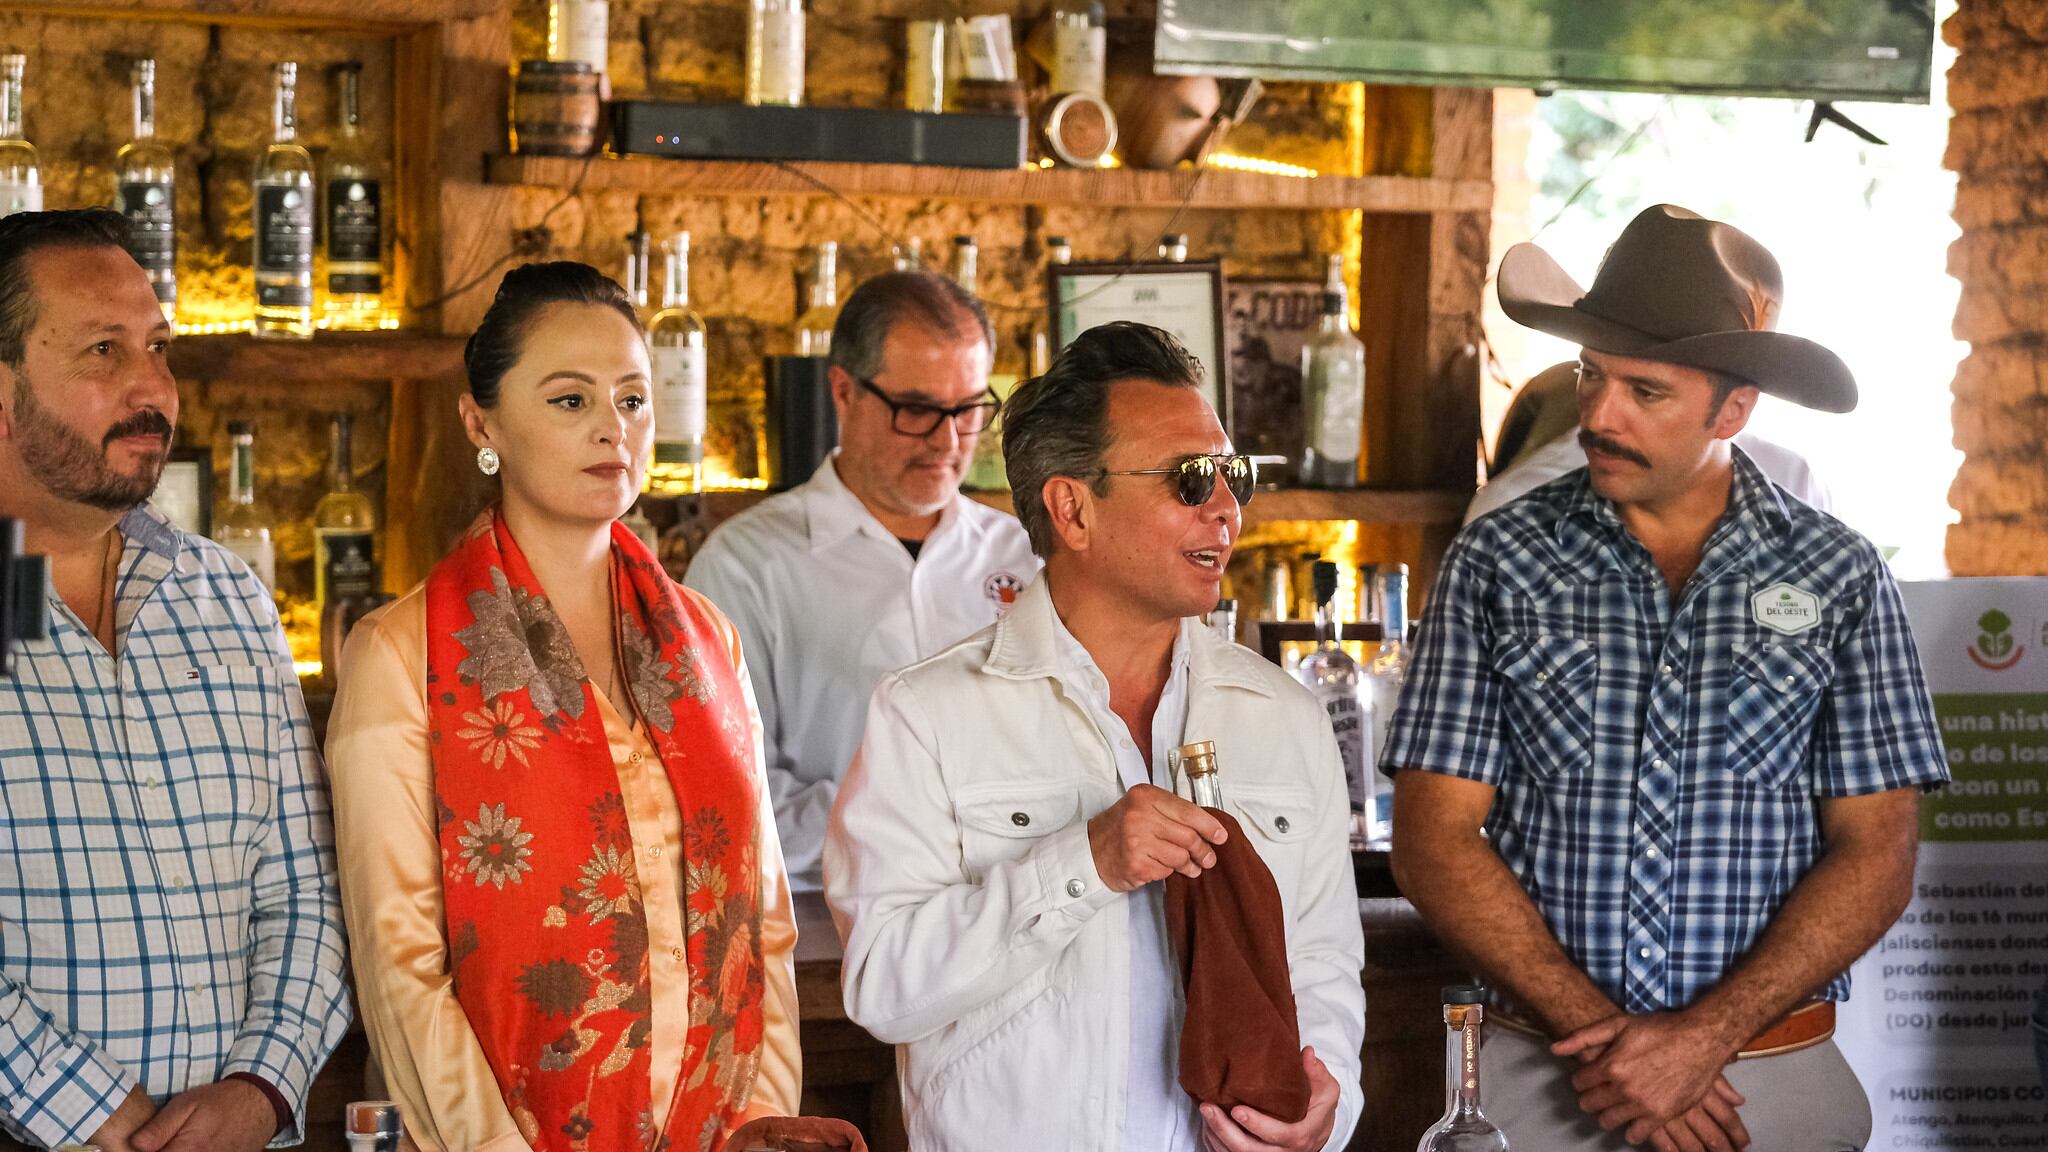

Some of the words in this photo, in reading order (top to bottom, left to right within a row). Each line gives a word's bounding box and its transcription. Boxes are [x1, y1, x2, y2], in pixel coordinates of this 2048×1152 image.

[1766, 607, 1782, 616] DEL
[1784, 607, 1809, 617] OESTE
[1943, 714, 1994, 732] una
[1969, 742, 2006, 764] de
[2005, 779, 2041, 796] un
[1935, 811, 2011, 830] como
[2016, 806, 2048, 829] Es
[1917, 881, 2016, 898] Sebastián
[1920, 909, 1944, 923] de
[1949, 909, 1978, 923] los
[1982, 909, 2001, 923] 16
[1880, 934, 1997, 953] jaliscienses
[1883, 959, 1965, 978] produce
[1970, 961, 2013, 976] este
[1884, 984, 2028, 1002] Denominación
[1886, 1011, 1933, 1030] (DO)
[1937, 1010, 1998, 1028] desde
[1890, 1085, 2010, 1103] MUNICIPIOS
